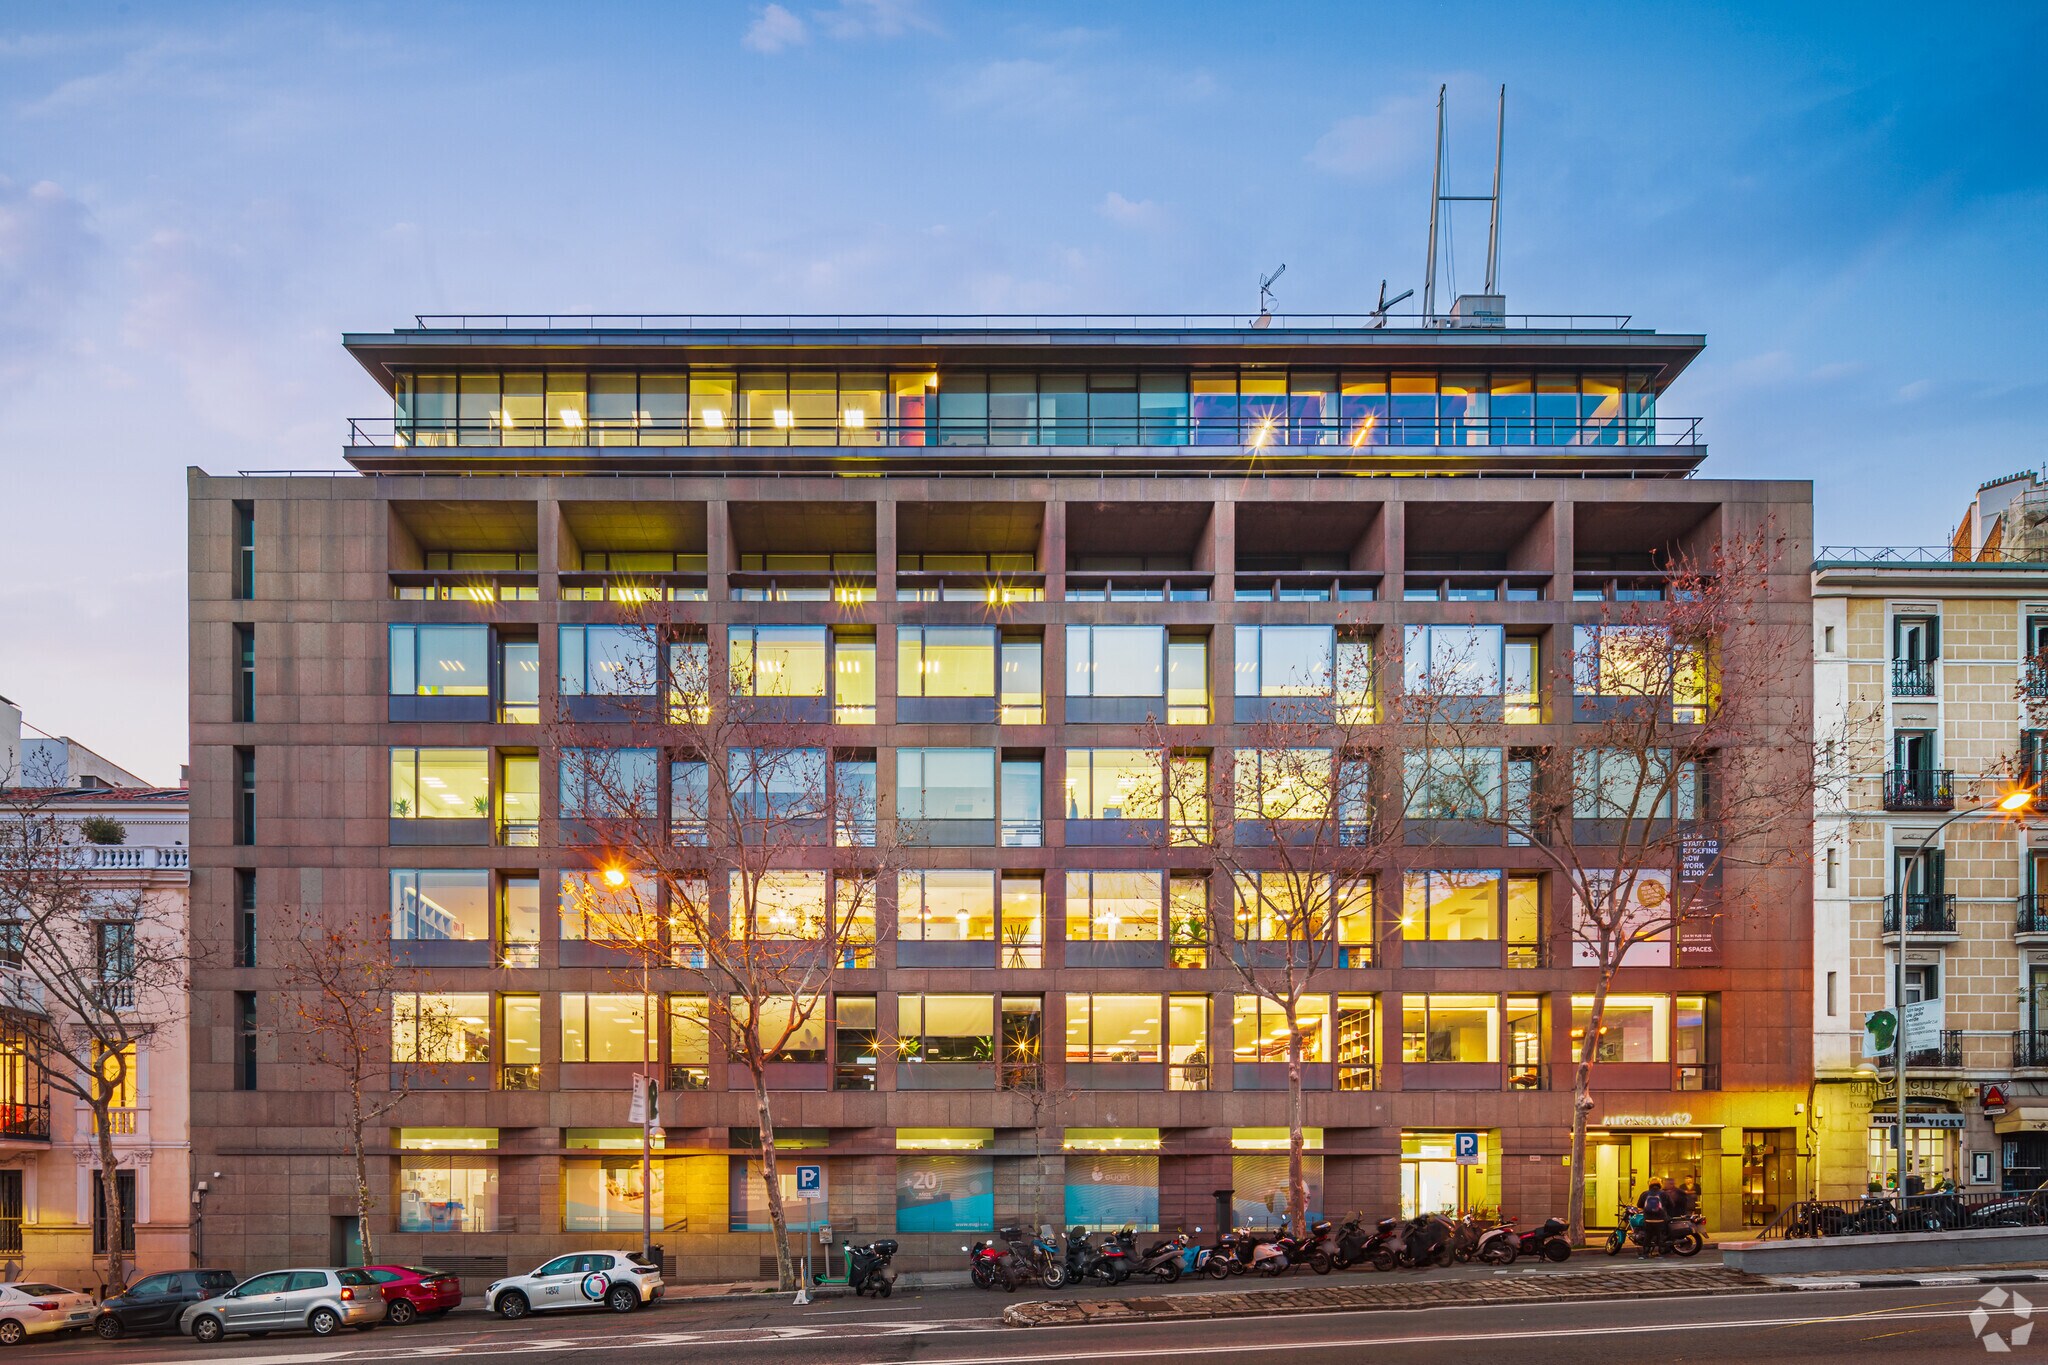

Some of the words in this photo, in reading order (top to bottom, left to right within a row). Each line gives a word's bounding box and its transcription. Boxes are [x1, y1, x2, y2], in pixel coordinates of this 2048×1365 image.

[1682, 869, 1690, 877] IS
[1928, 1119, 1965, 1127] VICKY
[1461, 1136, 1474, 1154] P
[801, 1169, 815, 1188] P
